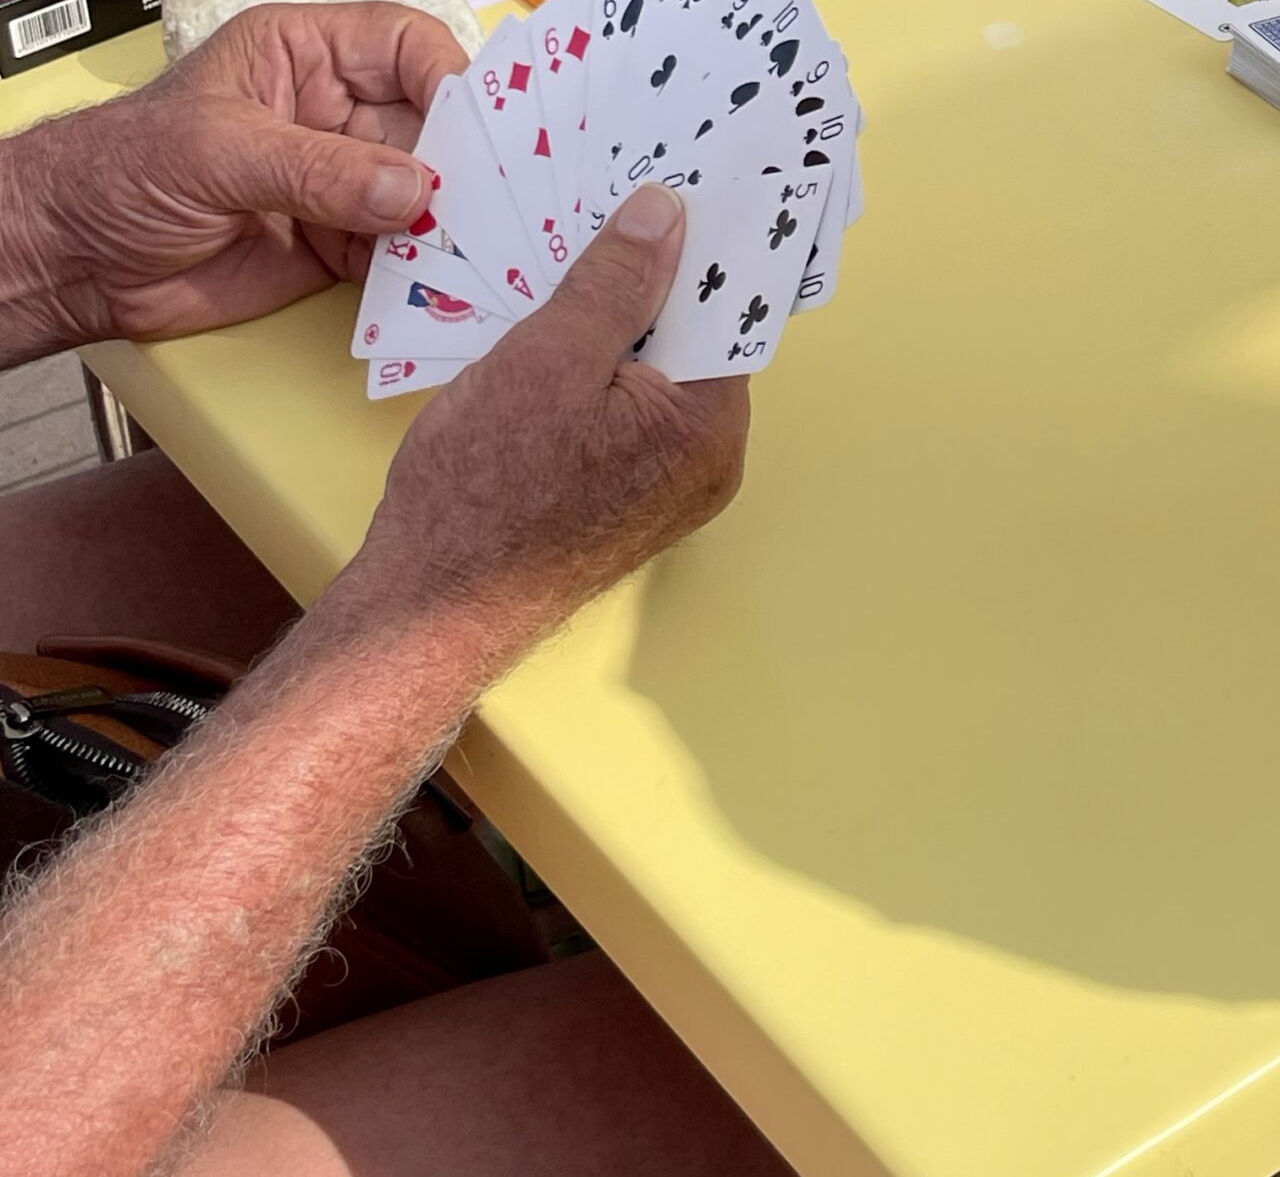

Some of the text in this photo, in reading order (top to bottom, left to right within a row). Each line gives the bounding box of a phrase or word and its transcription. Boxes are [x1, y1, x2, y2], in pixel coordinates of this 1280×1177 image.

[772, 0, 800, 33] 10
[544, 27, 560, 56] 6
[483, 69, 501, 97] 8
[806, 60, 830, 84] 9
[820, 114, 844, 141] 10
[795, 182, 818, 199] 5
[385, 237, 410, 261] K
[548, 233, 570, 263] 8
[513, 275, 535, 301] A
[800, 272, 826, 299] 10
[742, 341, 767, 358] 5
[379, 362, 403, 387] 10
